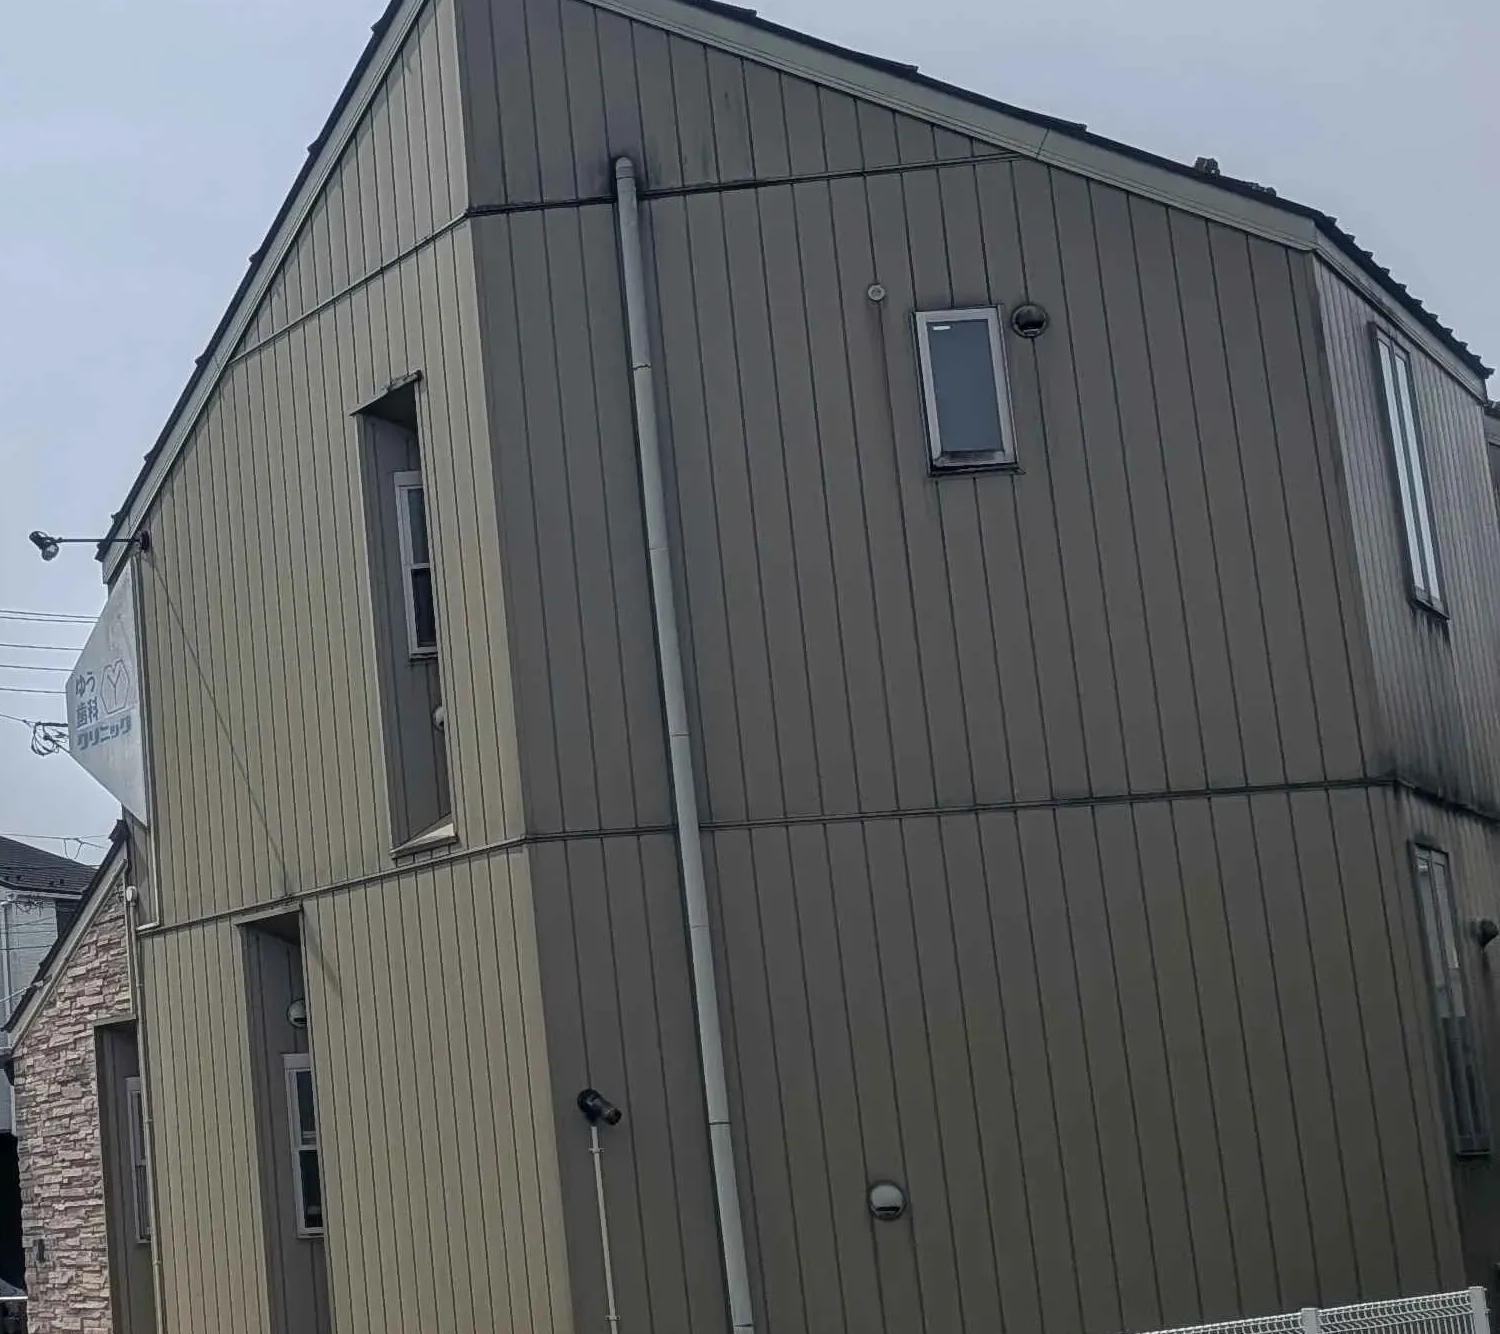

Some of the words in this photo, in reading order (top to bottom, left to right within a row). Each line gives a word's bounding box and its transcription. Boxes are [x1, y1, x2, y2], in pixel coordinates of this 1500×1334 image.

[77, 715, 132, 750] クリニック
